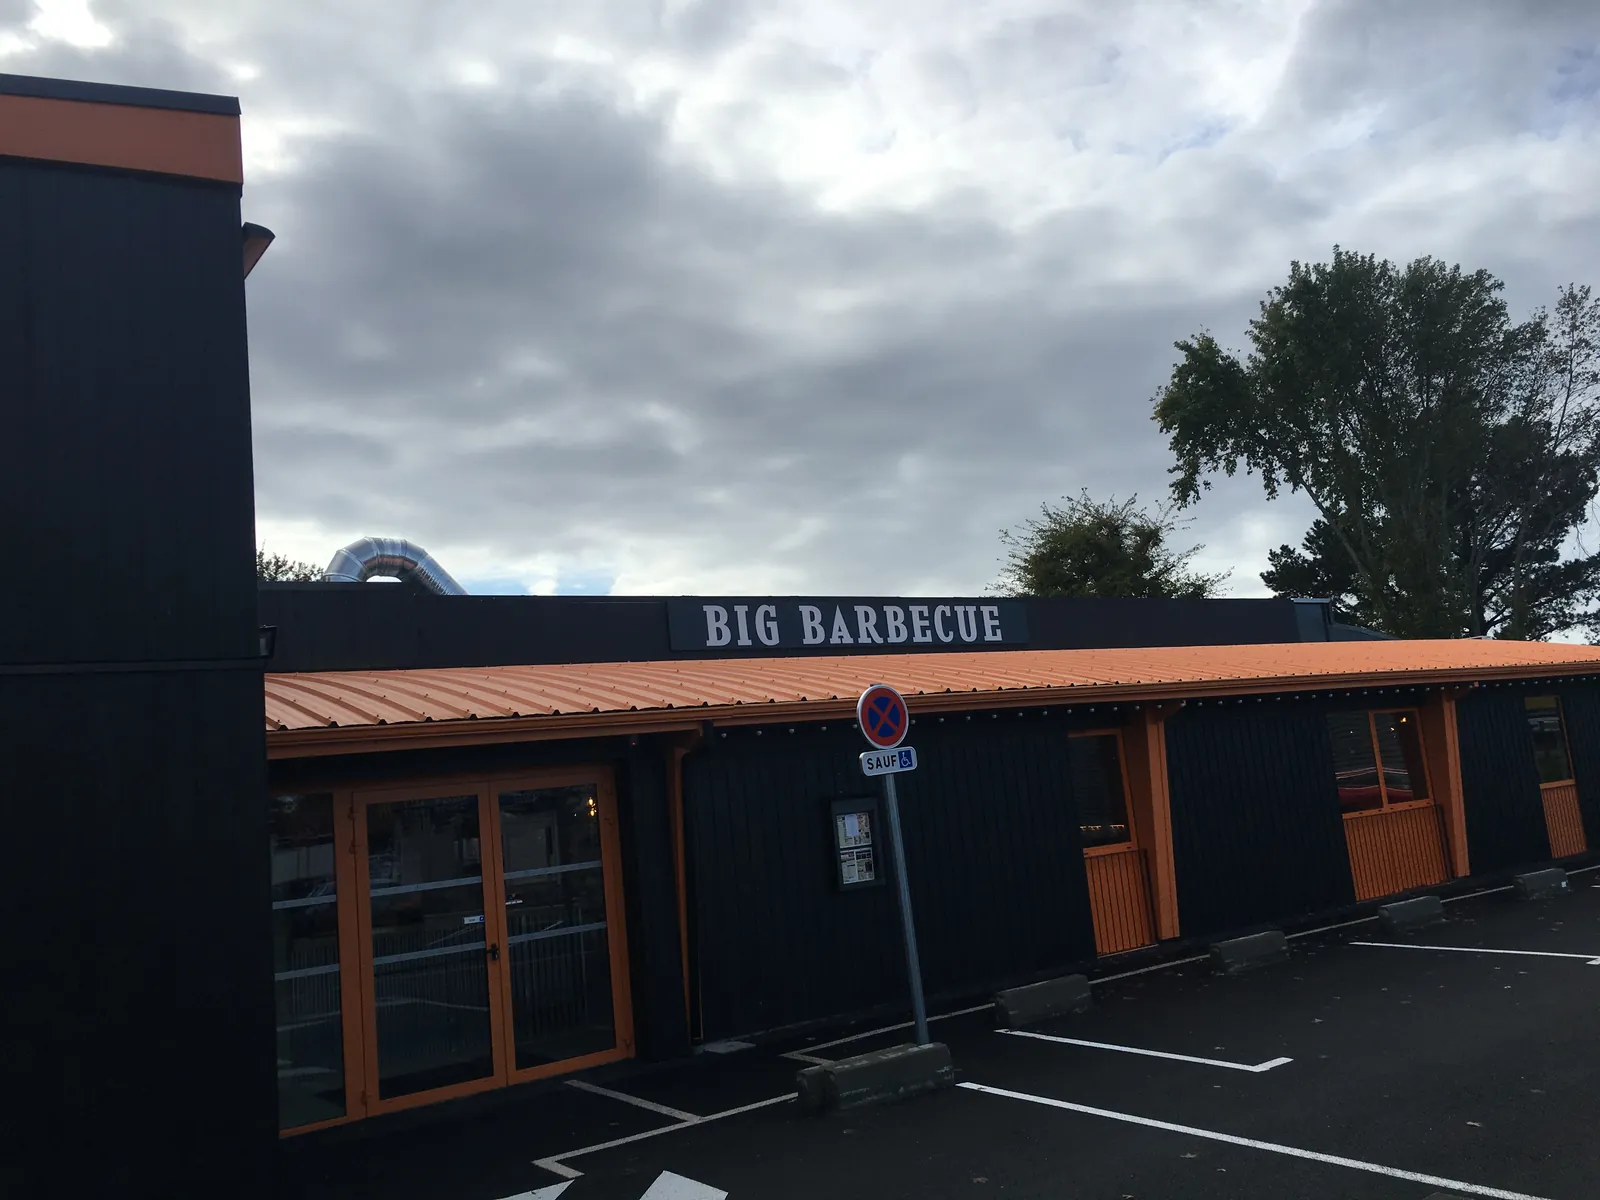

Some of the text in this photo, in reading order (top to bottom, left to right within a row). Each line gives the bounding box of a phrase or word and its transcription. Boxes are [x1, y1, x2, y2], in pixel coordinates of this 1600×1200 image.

[703, 605, 1002, 647] BIG BARBECUE
[867, 755, 897, 770] SAUF
